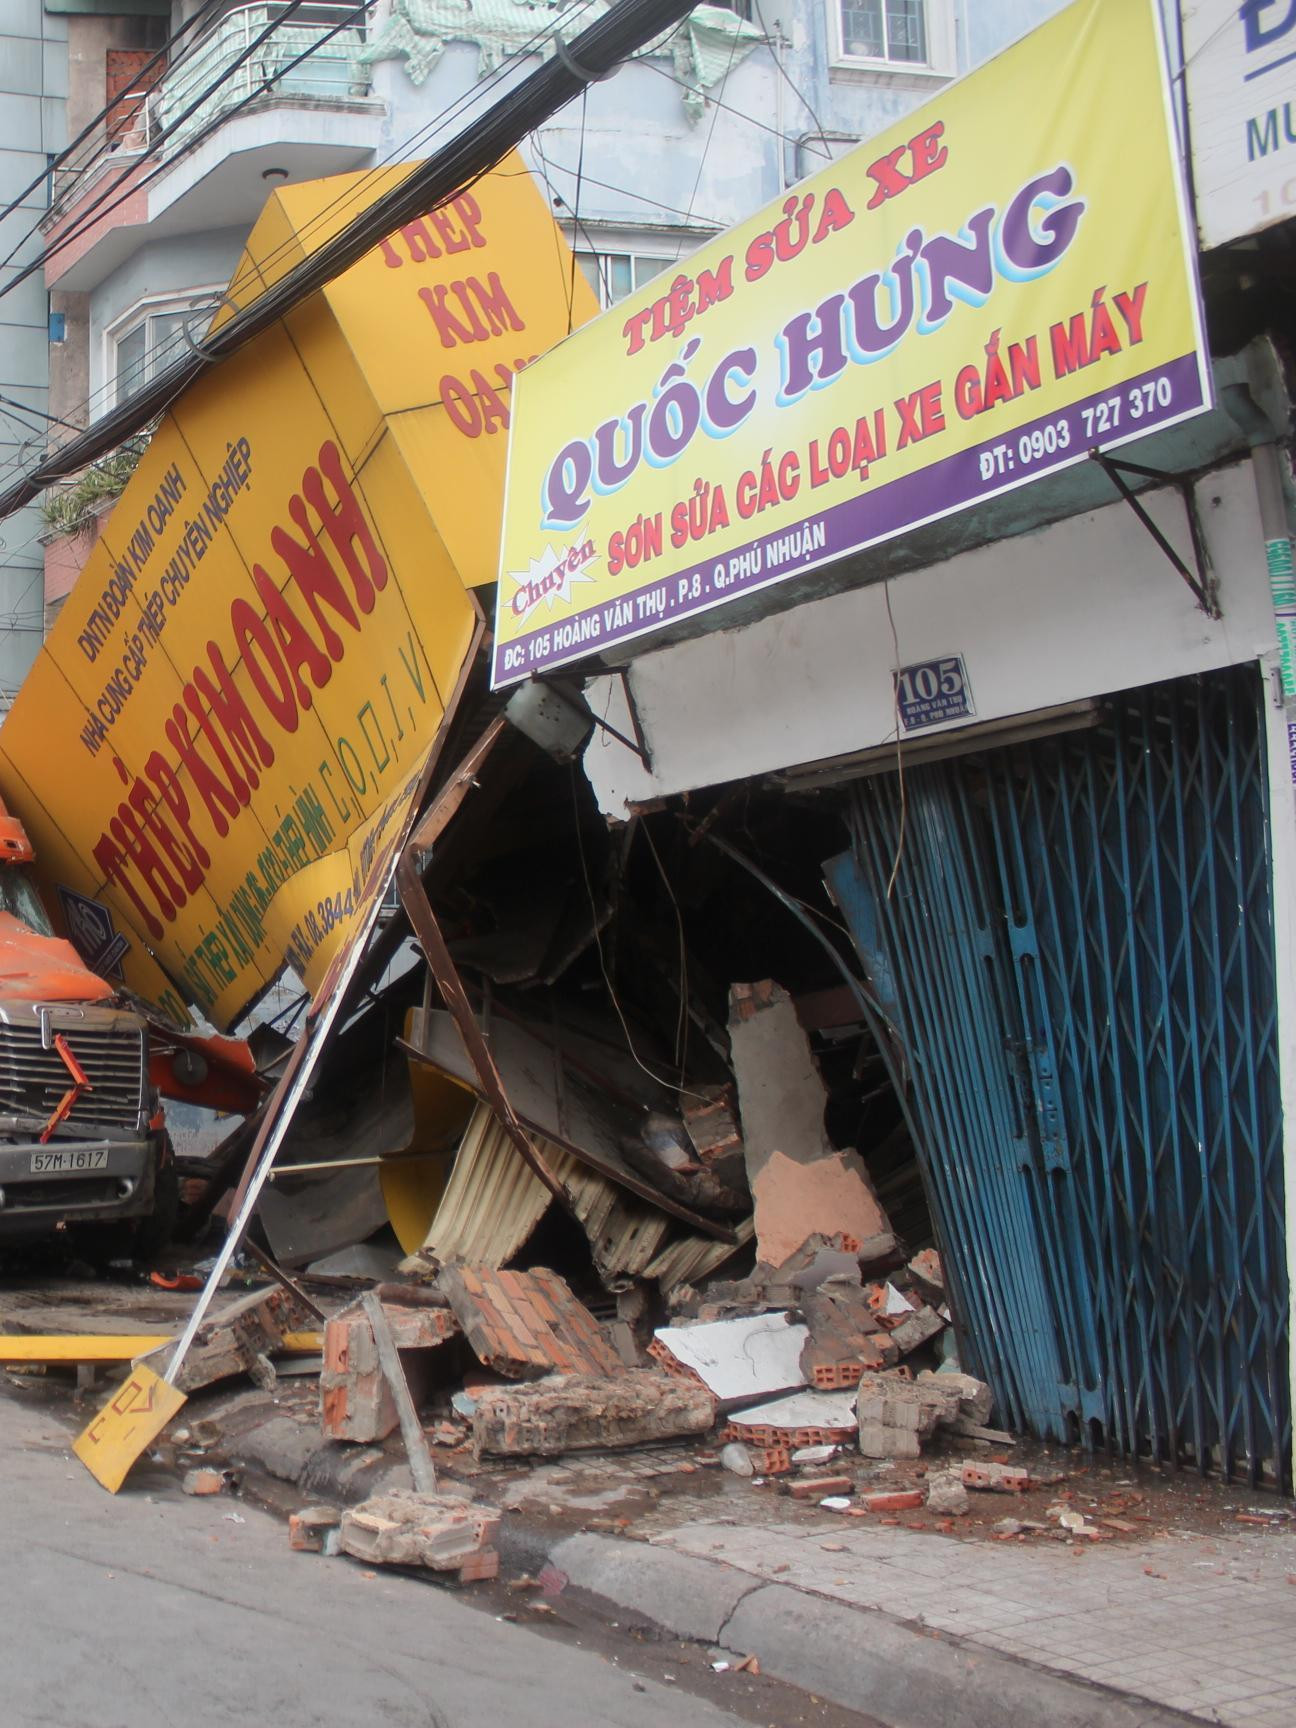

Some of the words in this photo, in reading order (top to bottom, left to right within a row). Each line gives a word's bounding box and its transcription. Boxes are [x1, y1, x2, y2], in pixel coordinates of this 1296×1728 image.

[417, 271, 526, 348] KIM
[543, 336, 759, 526] QUỐC
[779, 165, 1087, 402] HƯNG
[622, 254, 734, 356] TIỆM
[744, 188, 855, 282] SỬA
[866, 120, 949, 211] XE
[510, 538, 597, 617] Chuyên
[607, 512, 663, 576] SƠN
[670, 477, 730, 549] SỬA
[736, 447, 801, 520] CÁC
[809, 407, 887, 489] LOẠI
[894, 380, 946, 451] XE
[954, 327, 1041, 421] GẮN
[1050, 281, 1149, 380] MÁY
[979, 449, 1014, 481] ĐT:
[1019, 419, 1071, 465] 0903
[1081, 398, 1122, 439] 727
[1129, 376, 1173, 418] 370
[77, 607, 114, 664] DNTN
[127, 519, 156, 574] KIM
[147, 461, 187, 537] OANH
[79, 704, 109, 758] NHÀ
[96, 667, 132, 727] CUNG
[137, 591, 168, 651] THÉP
[159, 511, 213, 607] CHUYÊN
[202, 436, 253, 534] NGHIỆP
[504, 649, 525, 671] ĐC:
[528, 633, 551, 662] 105
[553, 612, 600, 652] HOÀNG
[604, 602, 633, 632] VĂN
[637, 588, 667, 619] THỤ
[678, 574, 702, 604] P.8
[714, 545, 762, 588] Q.PHÚ
[766, 522, 826, 569] NHUẬN
[92, 750, 212, 941] THÉP
[164, 640, 276, 839] KIM
[230, 440, 389, 734] OANH
[900, 660, 962, 704] 105
